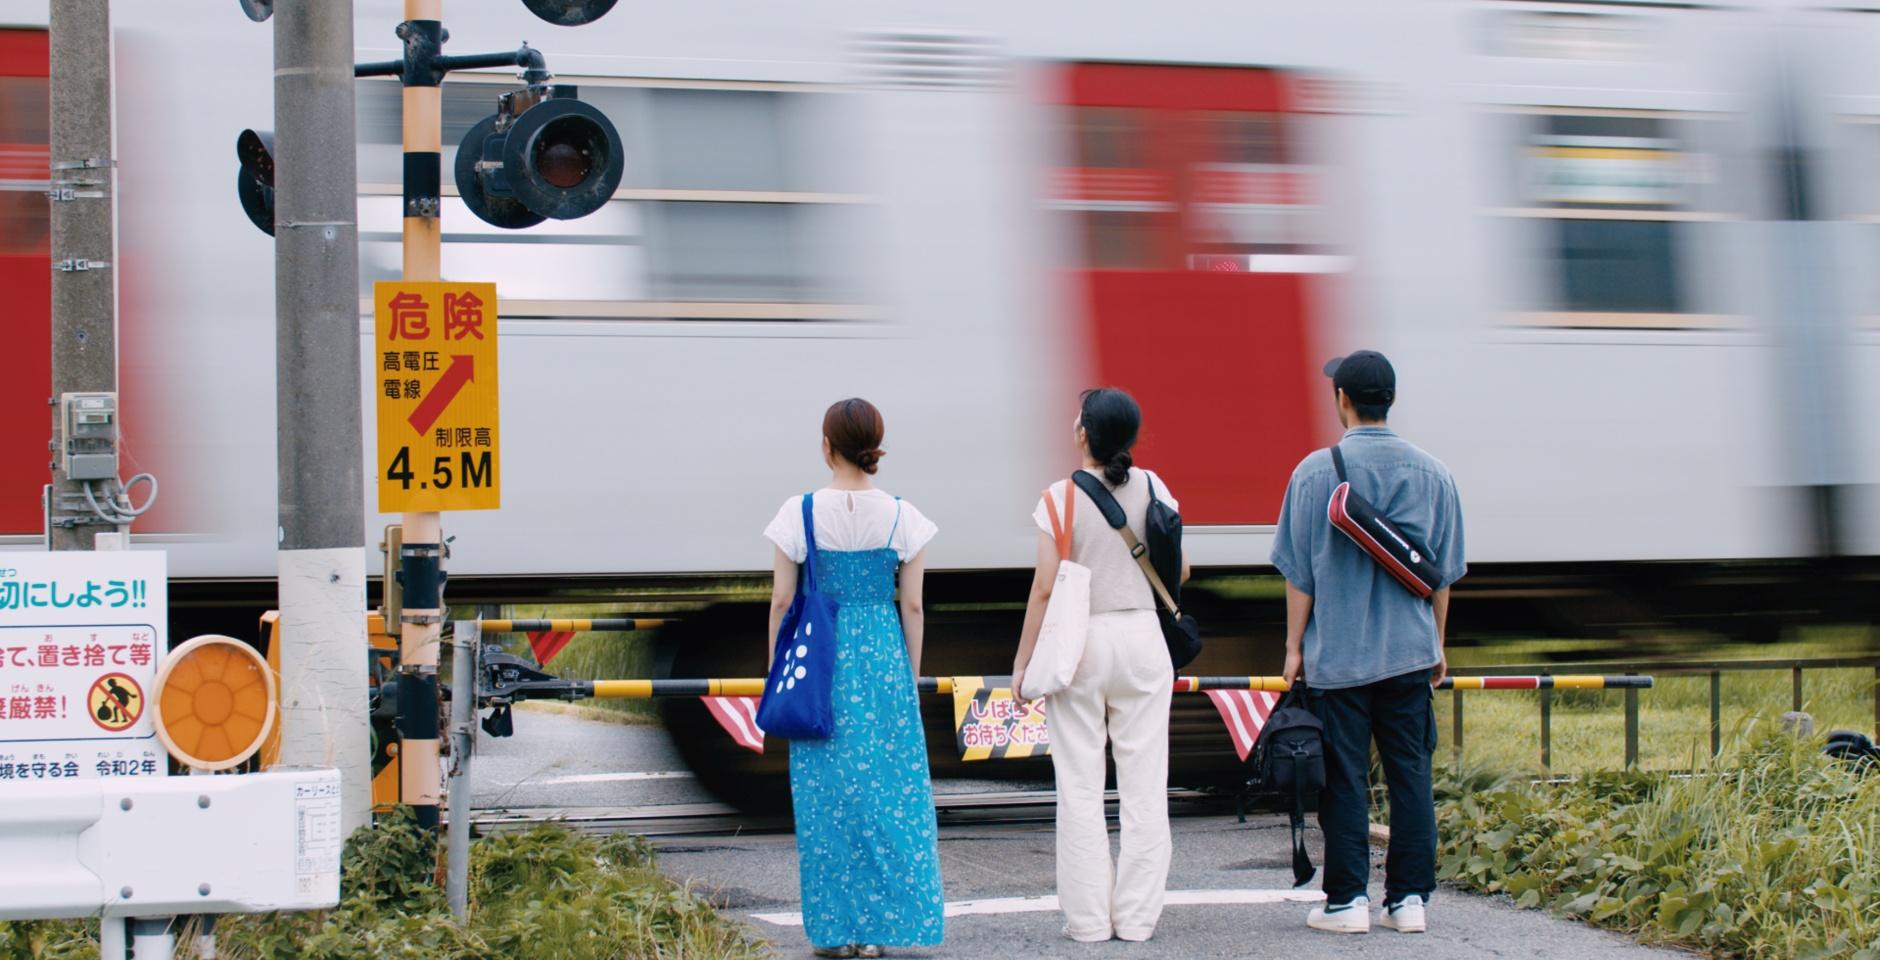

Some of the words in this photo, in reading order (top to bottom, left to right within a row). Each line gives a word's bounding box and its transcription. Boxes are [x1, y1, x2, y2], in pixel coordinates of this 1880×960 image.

[388, 290, 485, 341] 危険
[383, 351, 440, 371] 高電圧
[383, 379, 421, 400] 電線
[435, 427, 491, 448] 制限高
[387, 446, 492, 490] 4.5M
[0, 643, 151, 668] て、置き捨て等
[972, 700, 1046, 718] しばらく
[0, 760, 79, 779] 境を守る会
[96, 760, 157, 777] 令和2年
